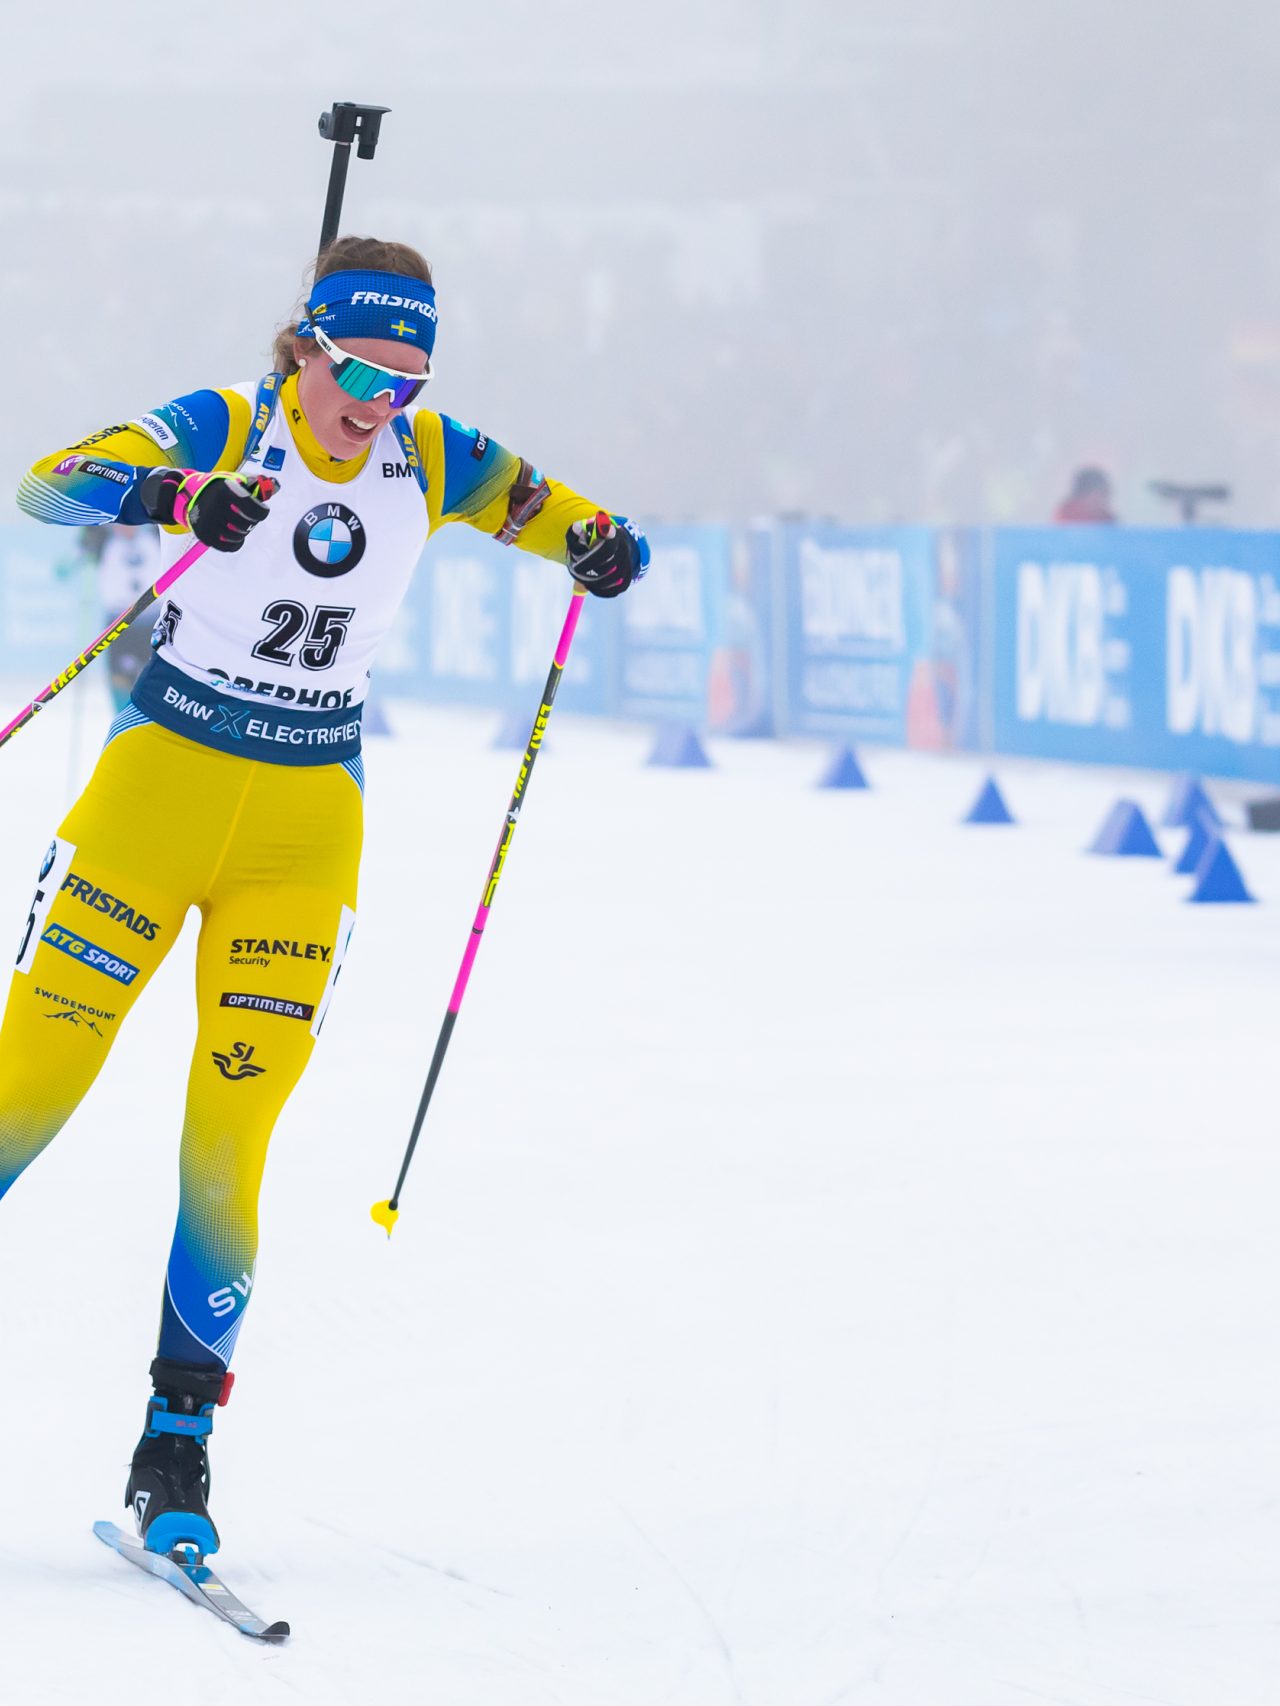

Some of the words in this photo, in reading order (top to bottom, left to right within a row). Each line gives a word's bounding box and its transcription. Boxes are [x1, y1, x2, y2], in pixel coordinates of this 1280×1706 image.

[401, 433, 419, 468] ATG
[382, 462, 412, 479] BM
[304, 504, 360, 532] BMW
[251, 600, 356, 672] 25
[163, 686, 214, 720] BMW
[207, 668, 355, 708] BERHOF
[530, 703, 553, 749] LEKI
[60, 873, 162, 942] FRISTADS
[44, 927, 86, 955] ATG
[83, 947, 137, 982] SPORT
[228, 956, 271, 968] Security
[34, 986, 116, 1022] SWEDEMOUNT
[227, 994, 304, 1017] OPTIMERA
[230, 1040, 256, 1063] SJ
